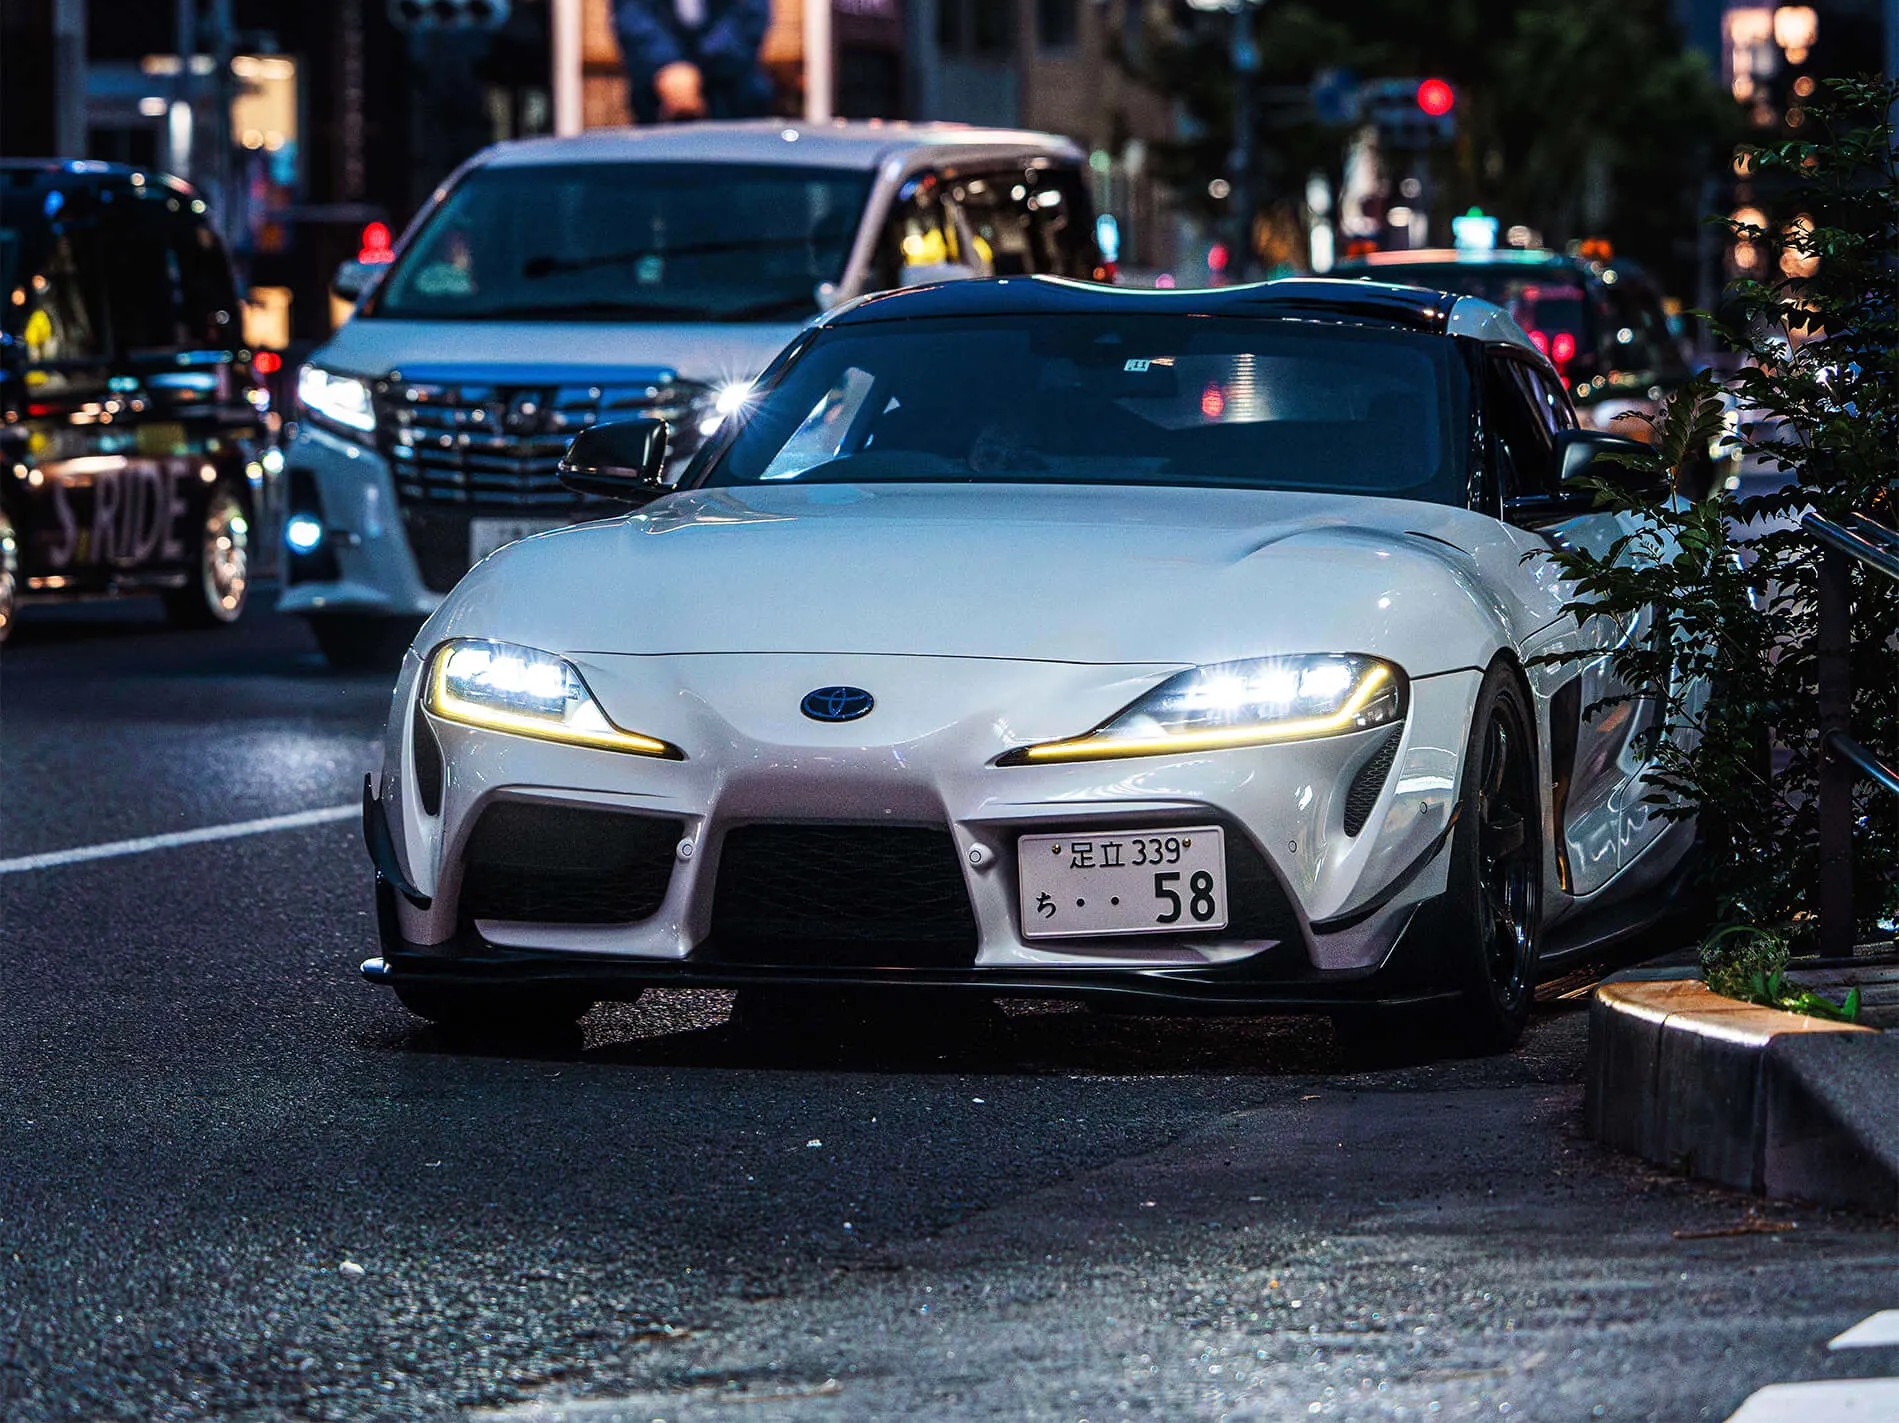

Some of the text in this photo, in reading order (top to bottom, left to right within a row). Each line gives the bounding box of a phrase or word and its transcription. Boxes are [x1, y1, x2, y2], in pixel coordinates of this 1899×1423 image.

[1070, 837, 1180, 868] 足立 339
[1036, 871, 1216, 923] ち 58
